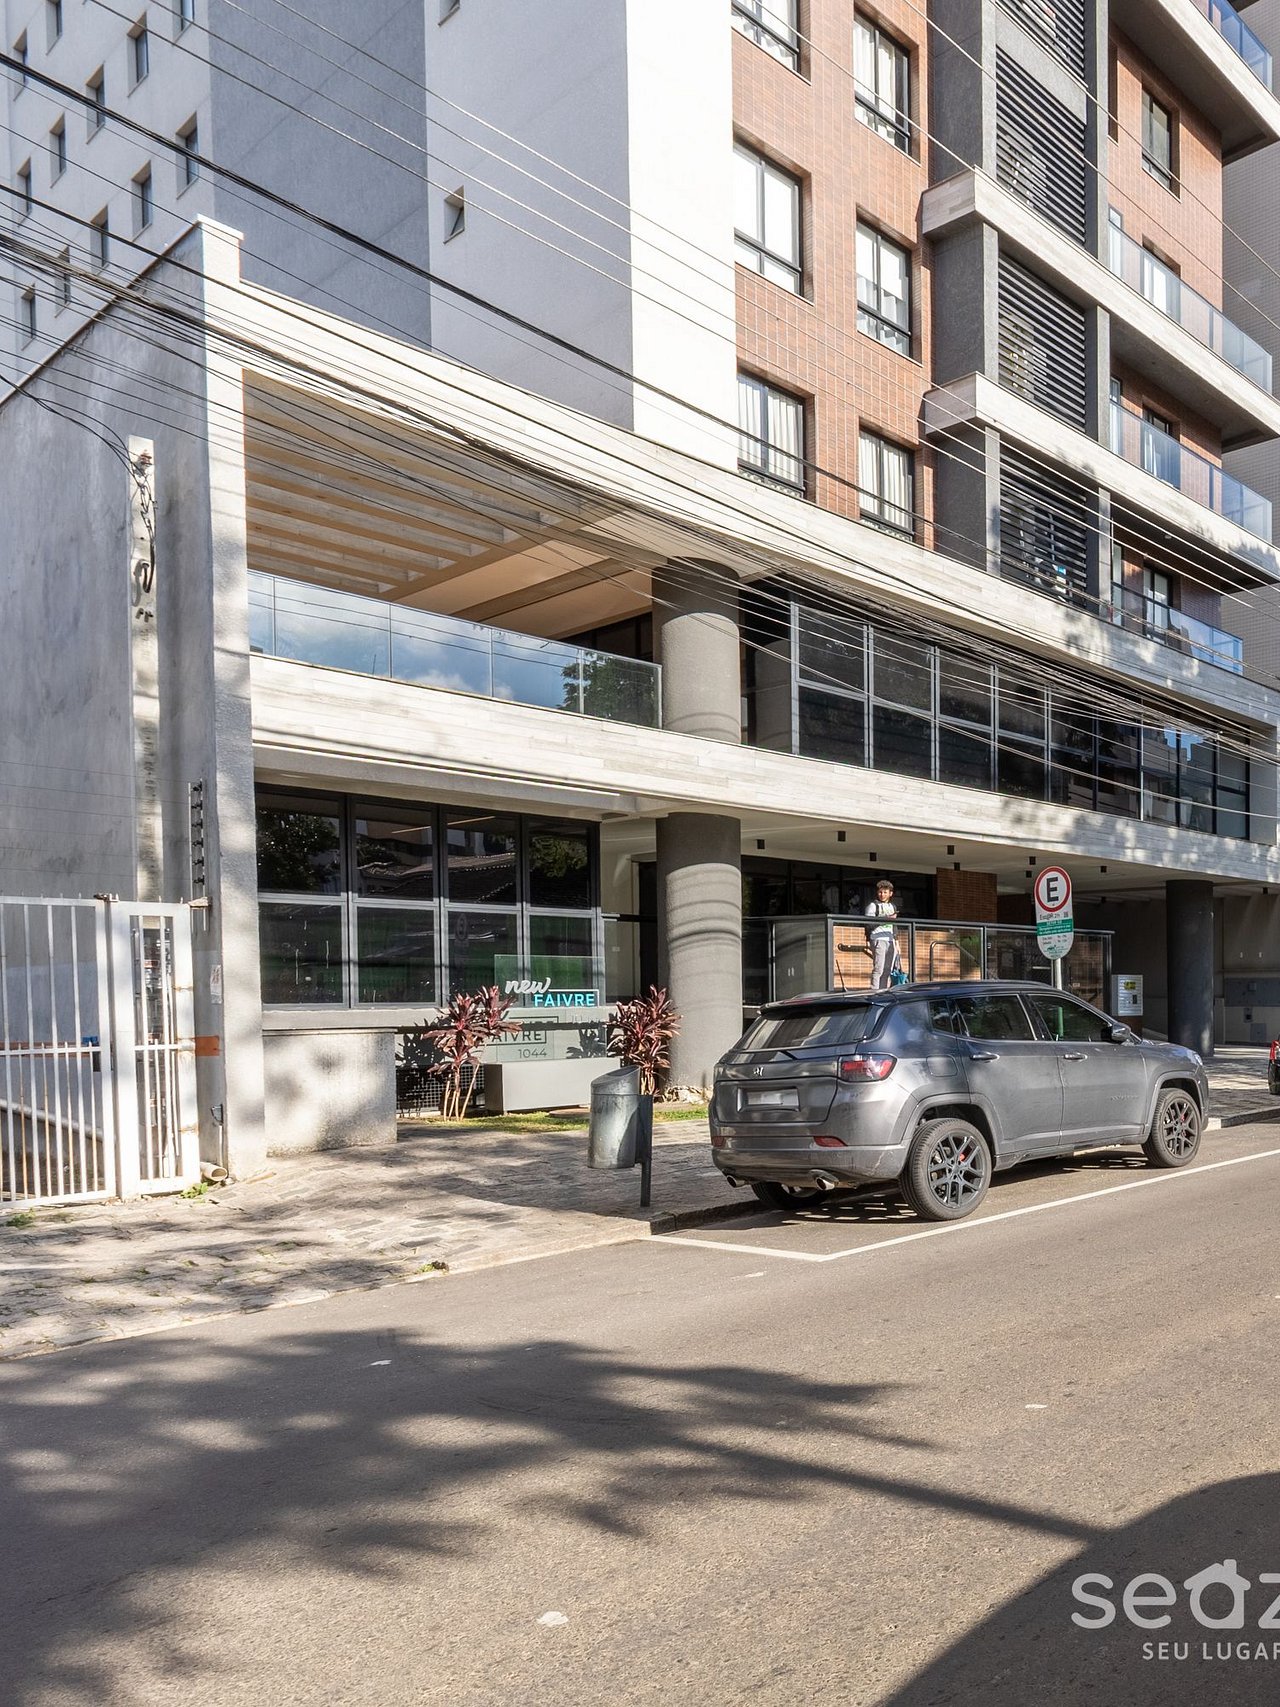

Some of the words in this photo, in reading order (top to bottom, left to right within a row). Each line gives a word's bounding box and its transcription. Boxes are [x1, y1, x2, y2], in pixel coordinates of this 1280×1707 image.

[1046, 876, 1059, 903] E
[505, 977, 551, 994] new
[534, 993, 596, 1007] FAIVRE
[518, 1048, 547, 1059] 1044
